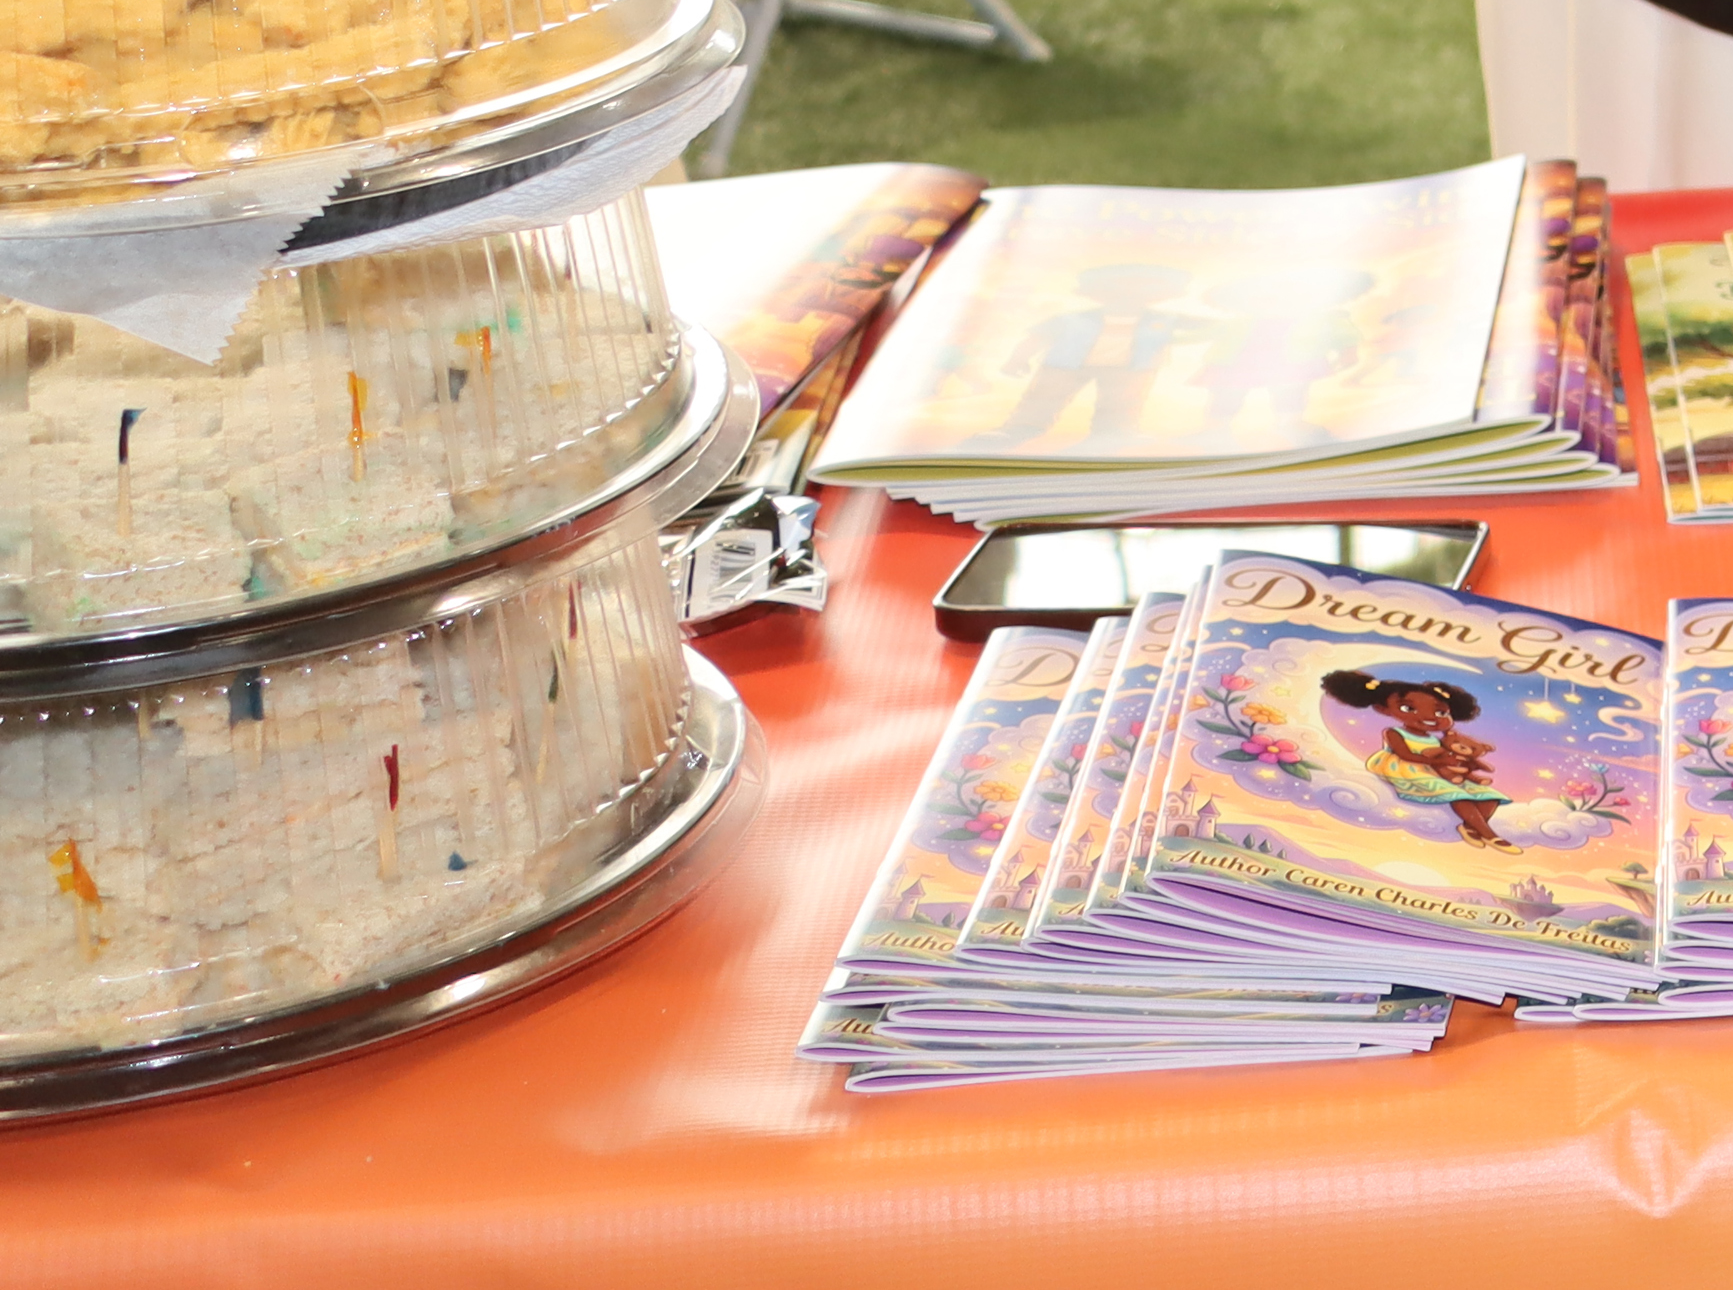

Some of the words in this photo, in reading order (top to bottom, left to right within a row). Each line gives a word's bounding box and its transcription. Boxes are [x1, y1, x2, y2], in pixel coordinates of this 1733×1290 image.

[1221, 568, 1482, 644] Dream
[1496, 620, 1647, 685] Girl
[864, 931, 955, 954] Autho
[1169, 849, 1277, 878] Author
[1285, 867, 1365, 898] Caren
[1375, 887, 1478, 921] Charles
[1489, 910, 1526, 931] De
[1536, 920, 1632, 953] Freitas
